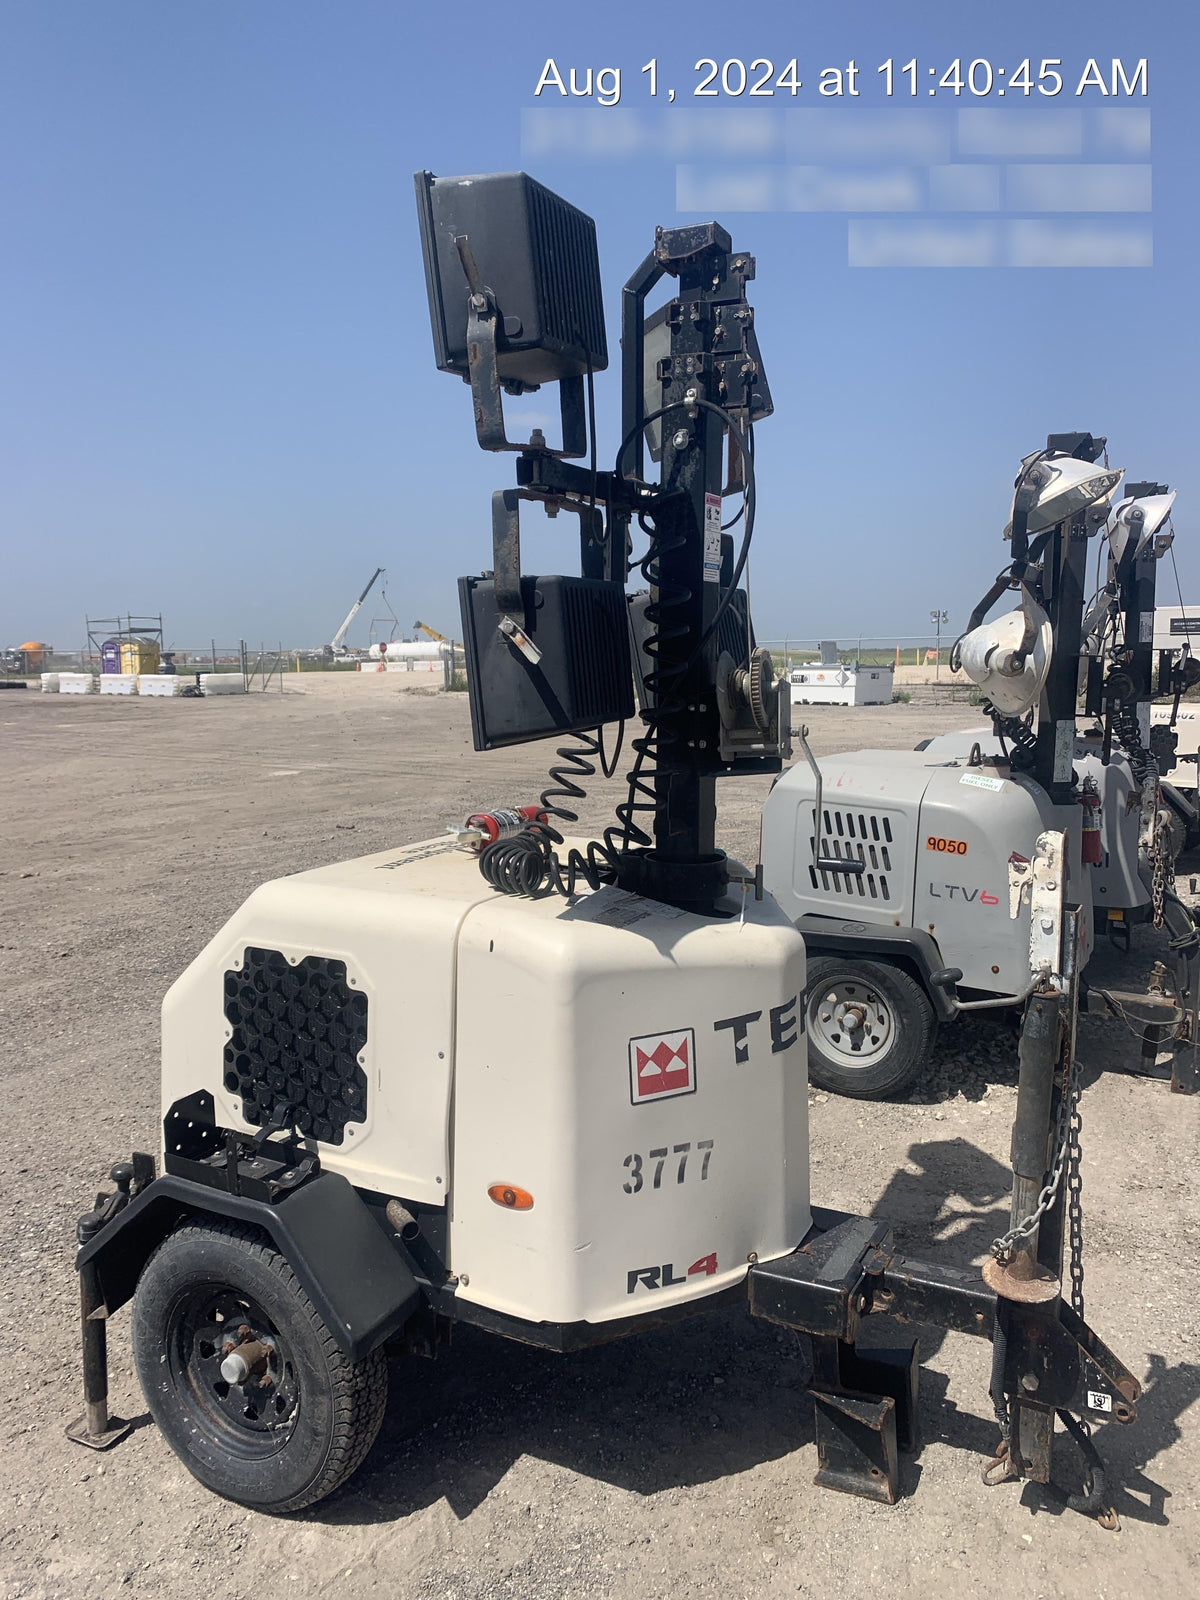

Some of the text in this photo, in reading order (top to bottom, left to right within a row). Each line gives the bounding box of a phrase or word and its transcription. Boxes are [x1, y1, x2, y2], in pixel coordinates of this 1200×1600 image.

[928, 837, 967, 854] 9050
[929, 883, 999, 905] LTV6
[622, 1140, 714, 1194] 3777
[627, 1252, 718, 1294] RL4
